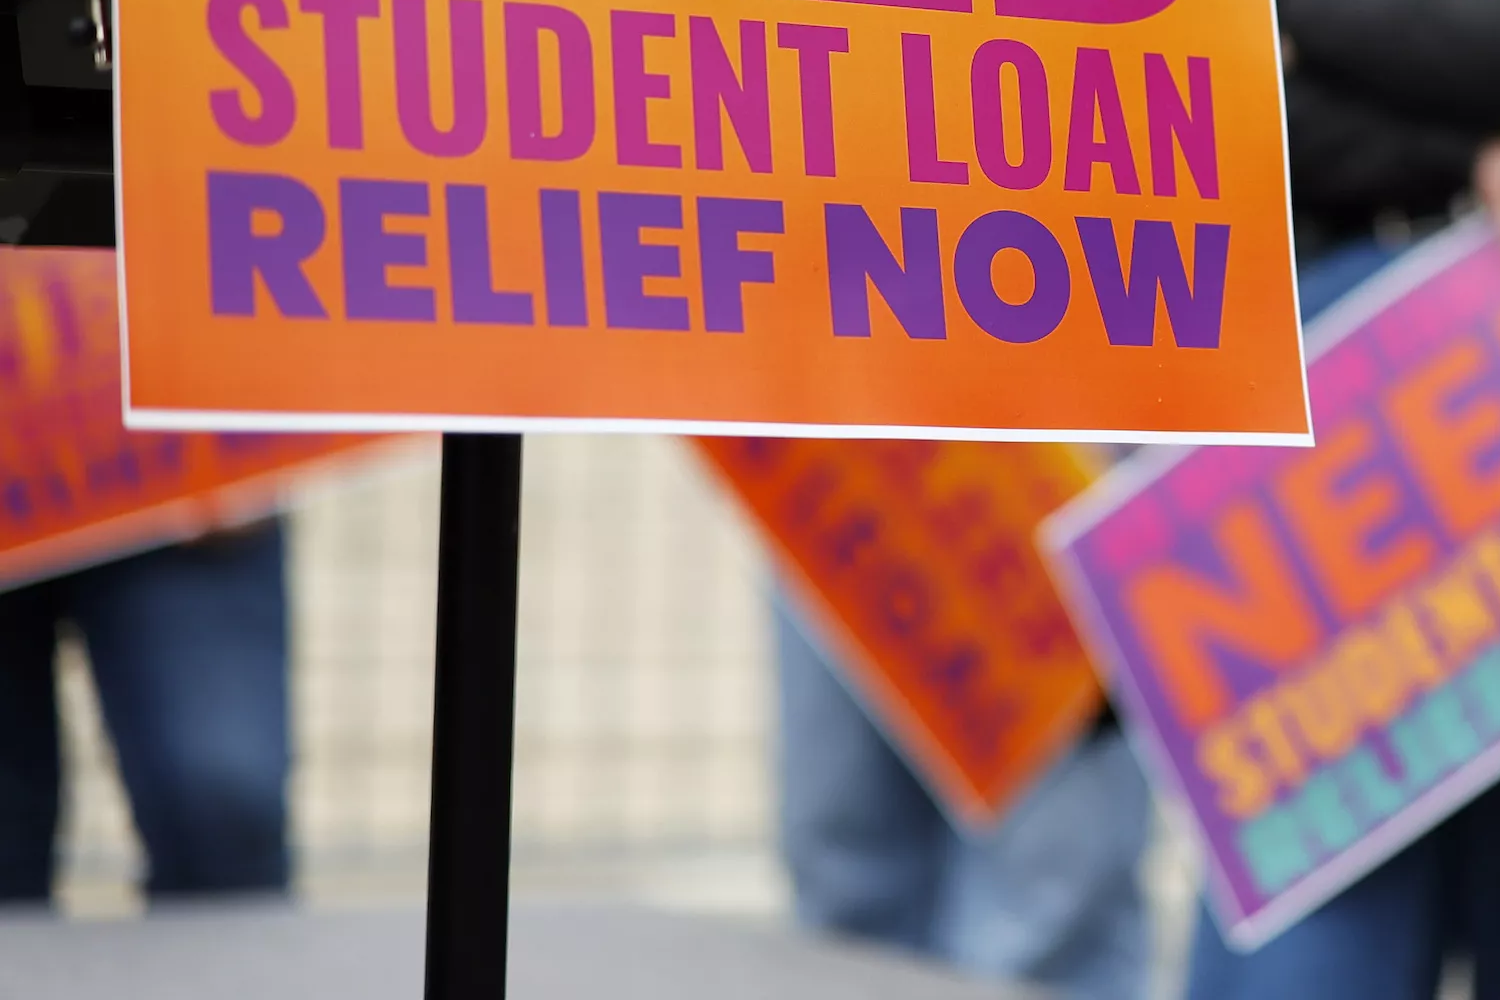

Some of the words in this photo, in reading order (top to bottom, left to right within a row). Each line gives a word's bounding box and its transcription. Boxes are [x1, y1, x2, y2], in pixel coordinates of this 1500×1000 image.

[900, 31, 1220, 200] LOAN
[205, 170, 785, 333] RELIEF
[823, 202, 1231, 350] NOW
